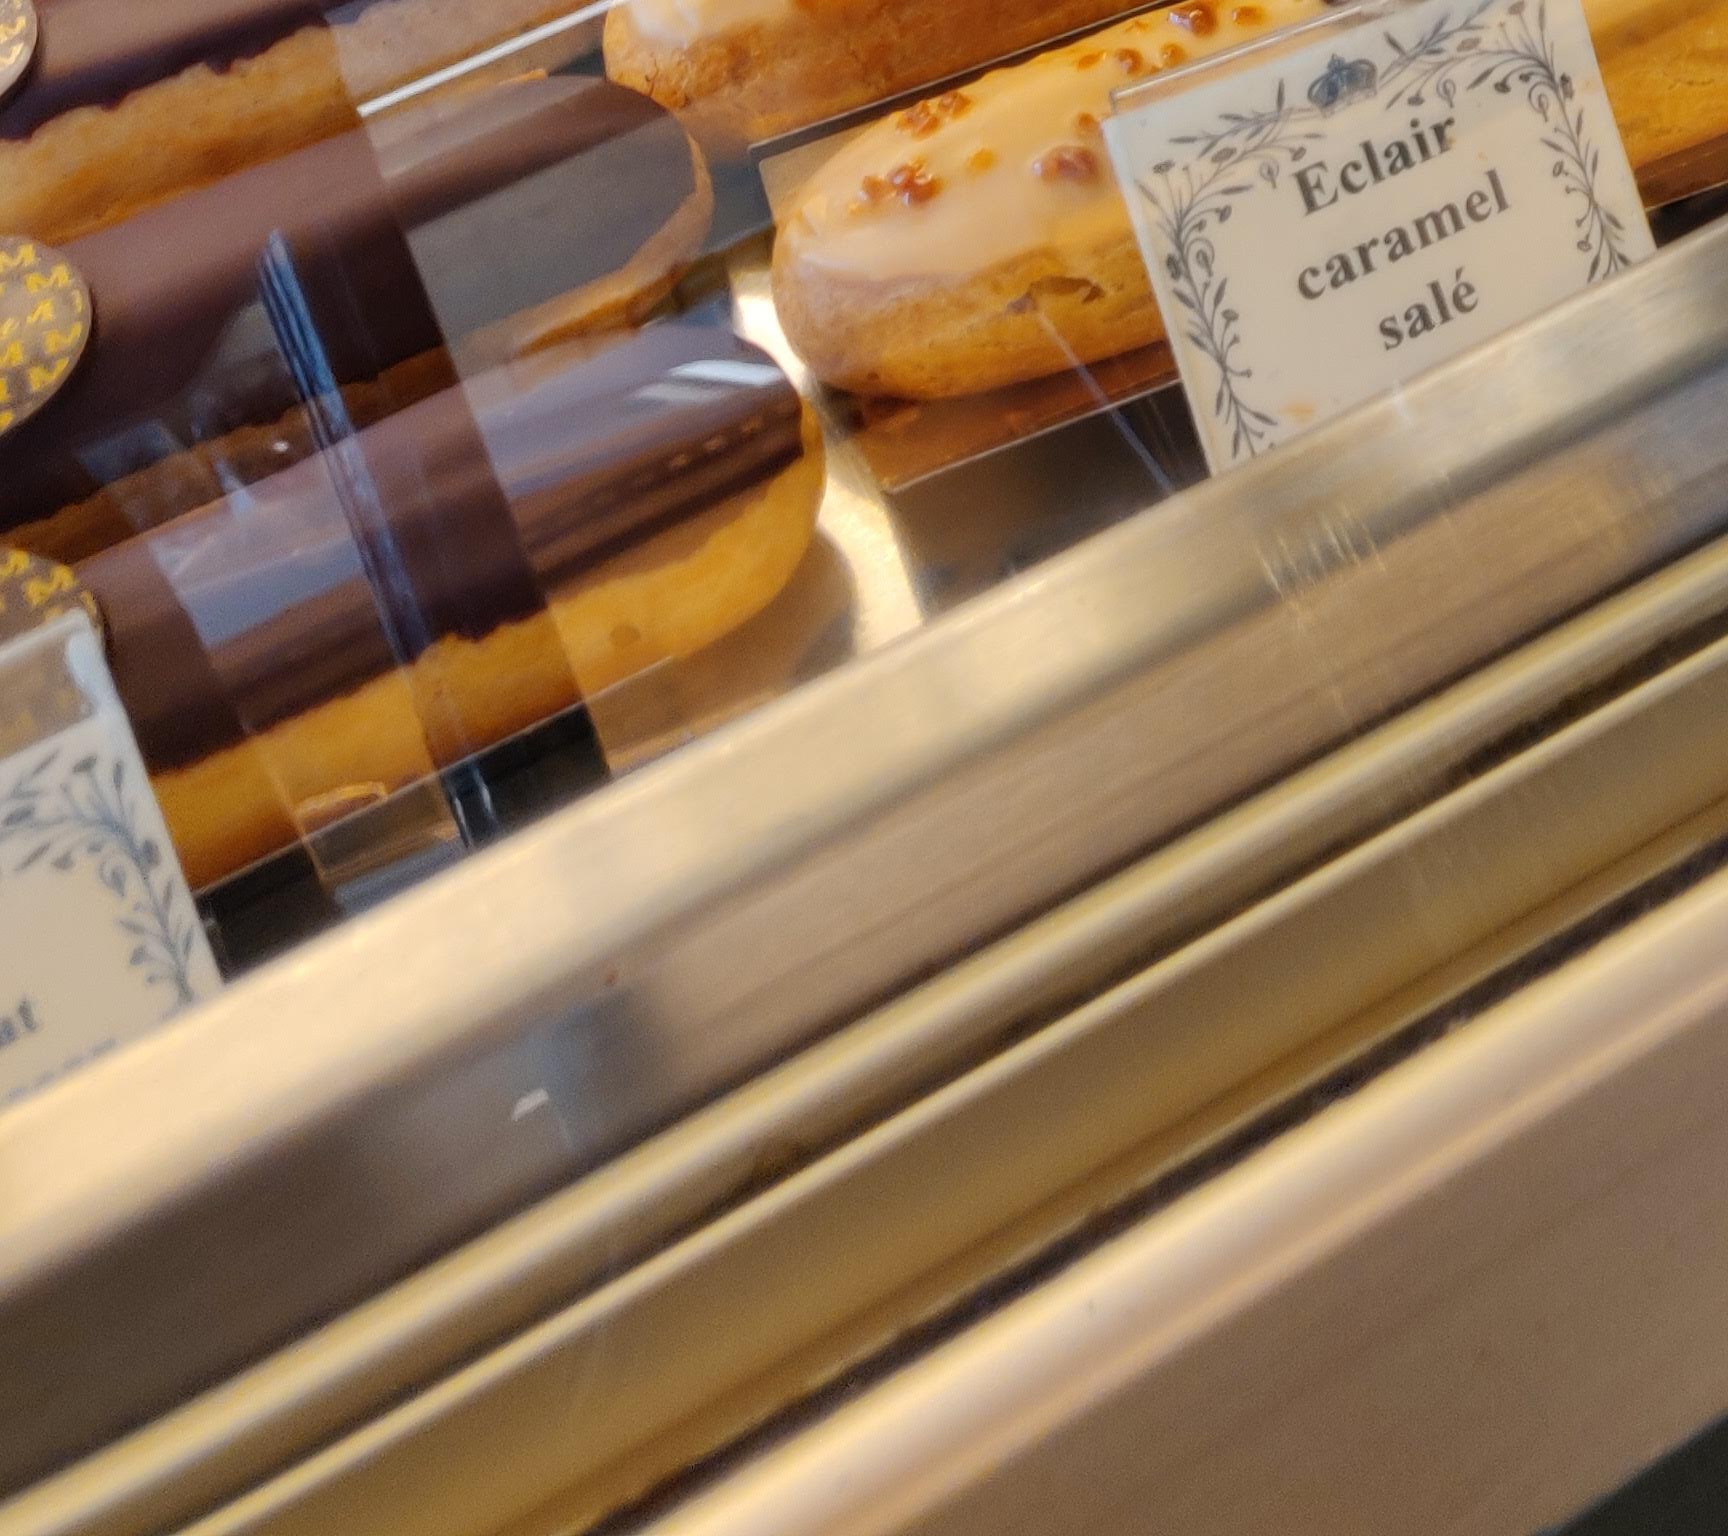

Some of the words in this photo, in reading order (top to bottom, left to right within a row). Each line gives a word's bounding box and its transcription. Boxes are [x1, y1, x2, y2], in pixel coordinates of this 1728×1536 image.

[1291, 117, 1455, 216] Eclair
[1298, 169, 1511, 300] caramel
[1379, 266, 1479, 350] salé
